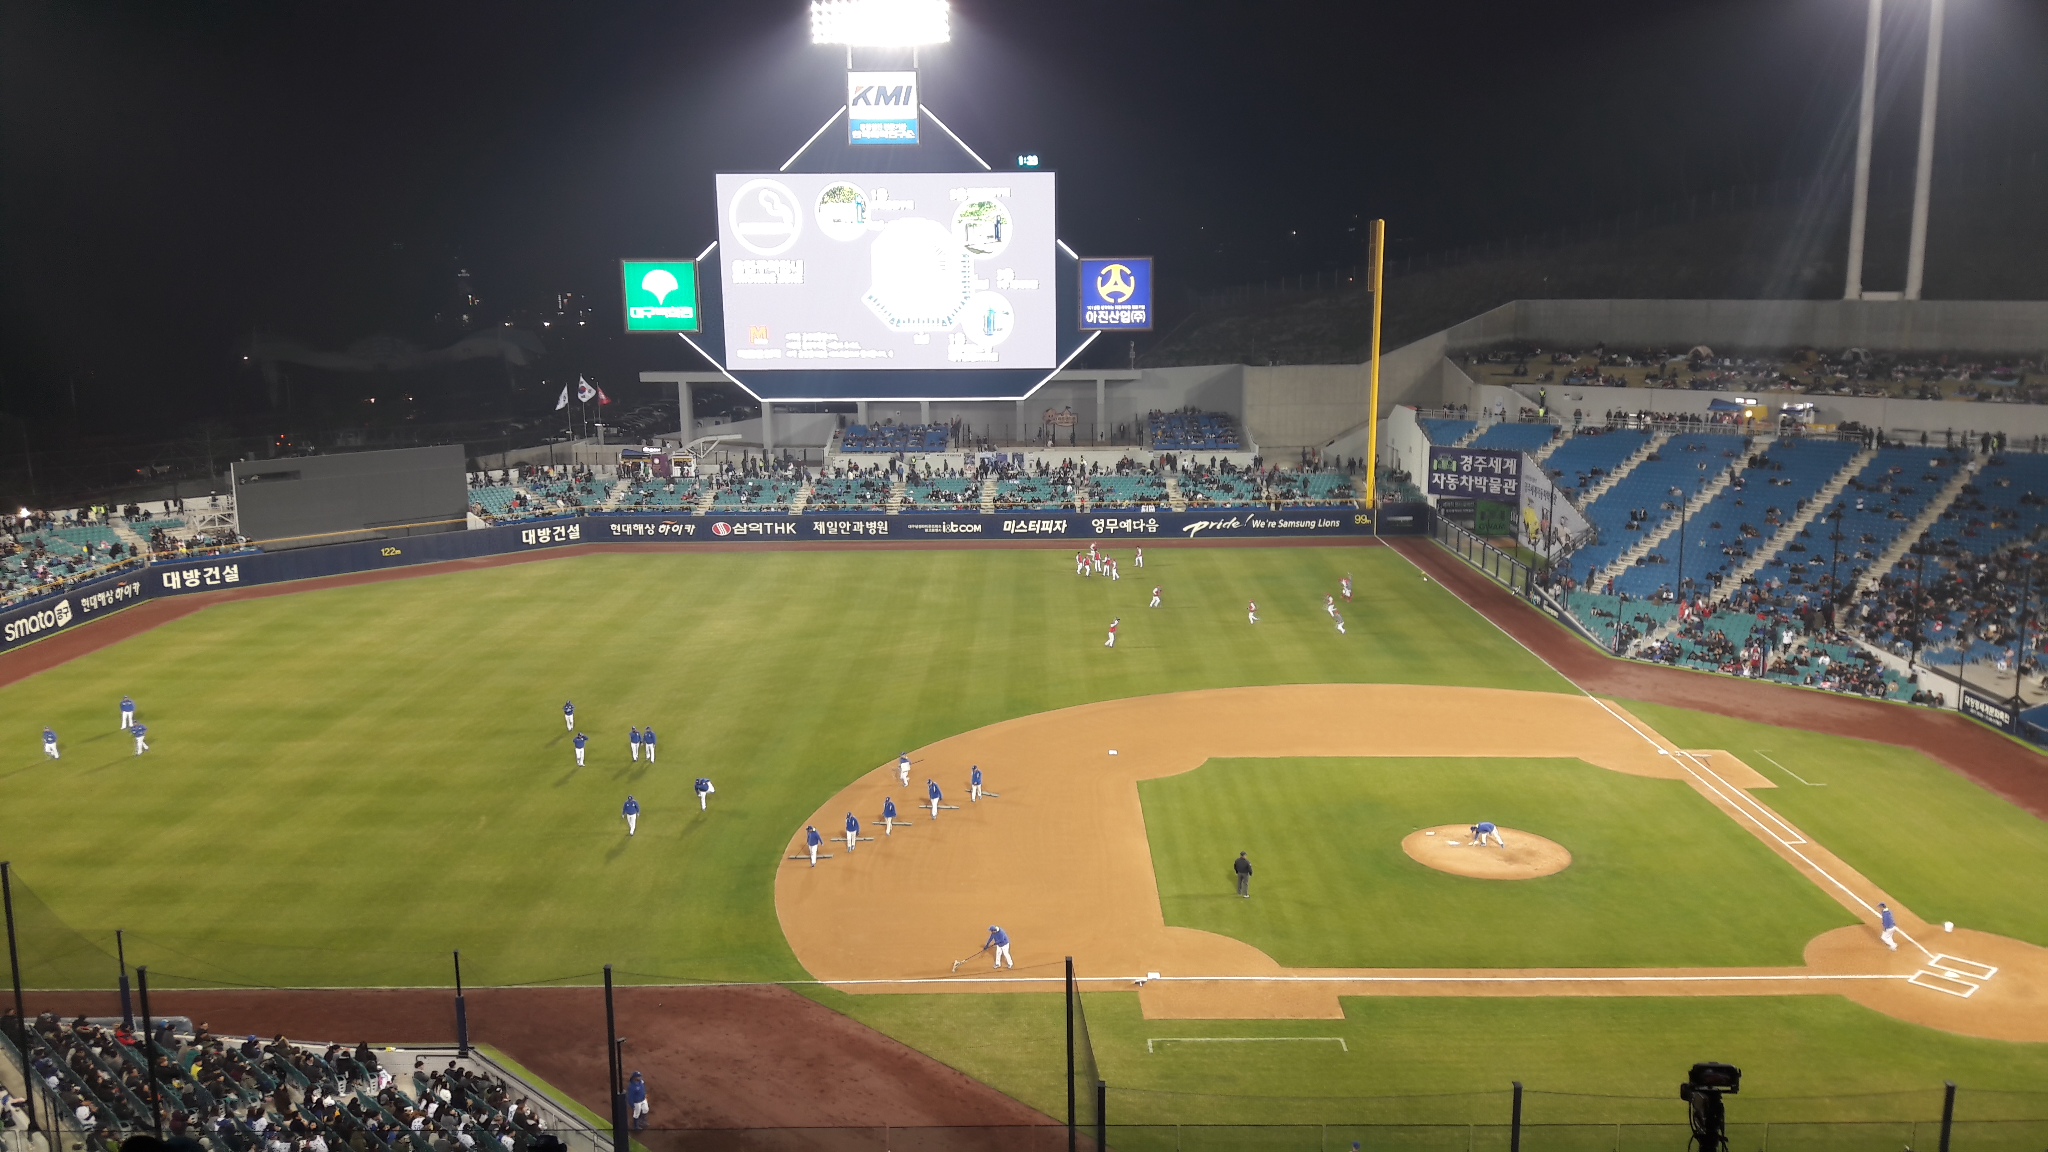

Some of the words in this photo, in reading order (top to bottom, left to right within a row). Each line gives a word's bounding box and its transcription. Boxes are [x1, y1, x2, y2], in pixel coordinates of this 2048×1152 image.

[851, 85, 913, 107] KMI
[1459, 454, 1518, 476] 경주세계
[1432, 473, 1518, 496] 자동차박물관
[813, 520, 889, 535] 제일안과병원
[1002, 519, 1068, 534] 미스터피자
[1091, 517, 1160, 534] 영무예다음
[1252, 518, 1277, 529] We're
[1278, 518, 1317, 530] Samsung
[1318, 518, 1341, 528] Lions
[1354, 514, 1372, 525] 99m
[521, 523, 581, 545] 대방건설
[609, 523, 656, 536] 현대해상
[658, 523, 697, 536] 하이카
[380, 546, 402, 557] 122m
[162, 564, 240, 590] 대방건설
[80, 590, 115, 614] 현대해상
[114, 581, 141, 602] 하이카
[4, 610, 55, 642] smato
